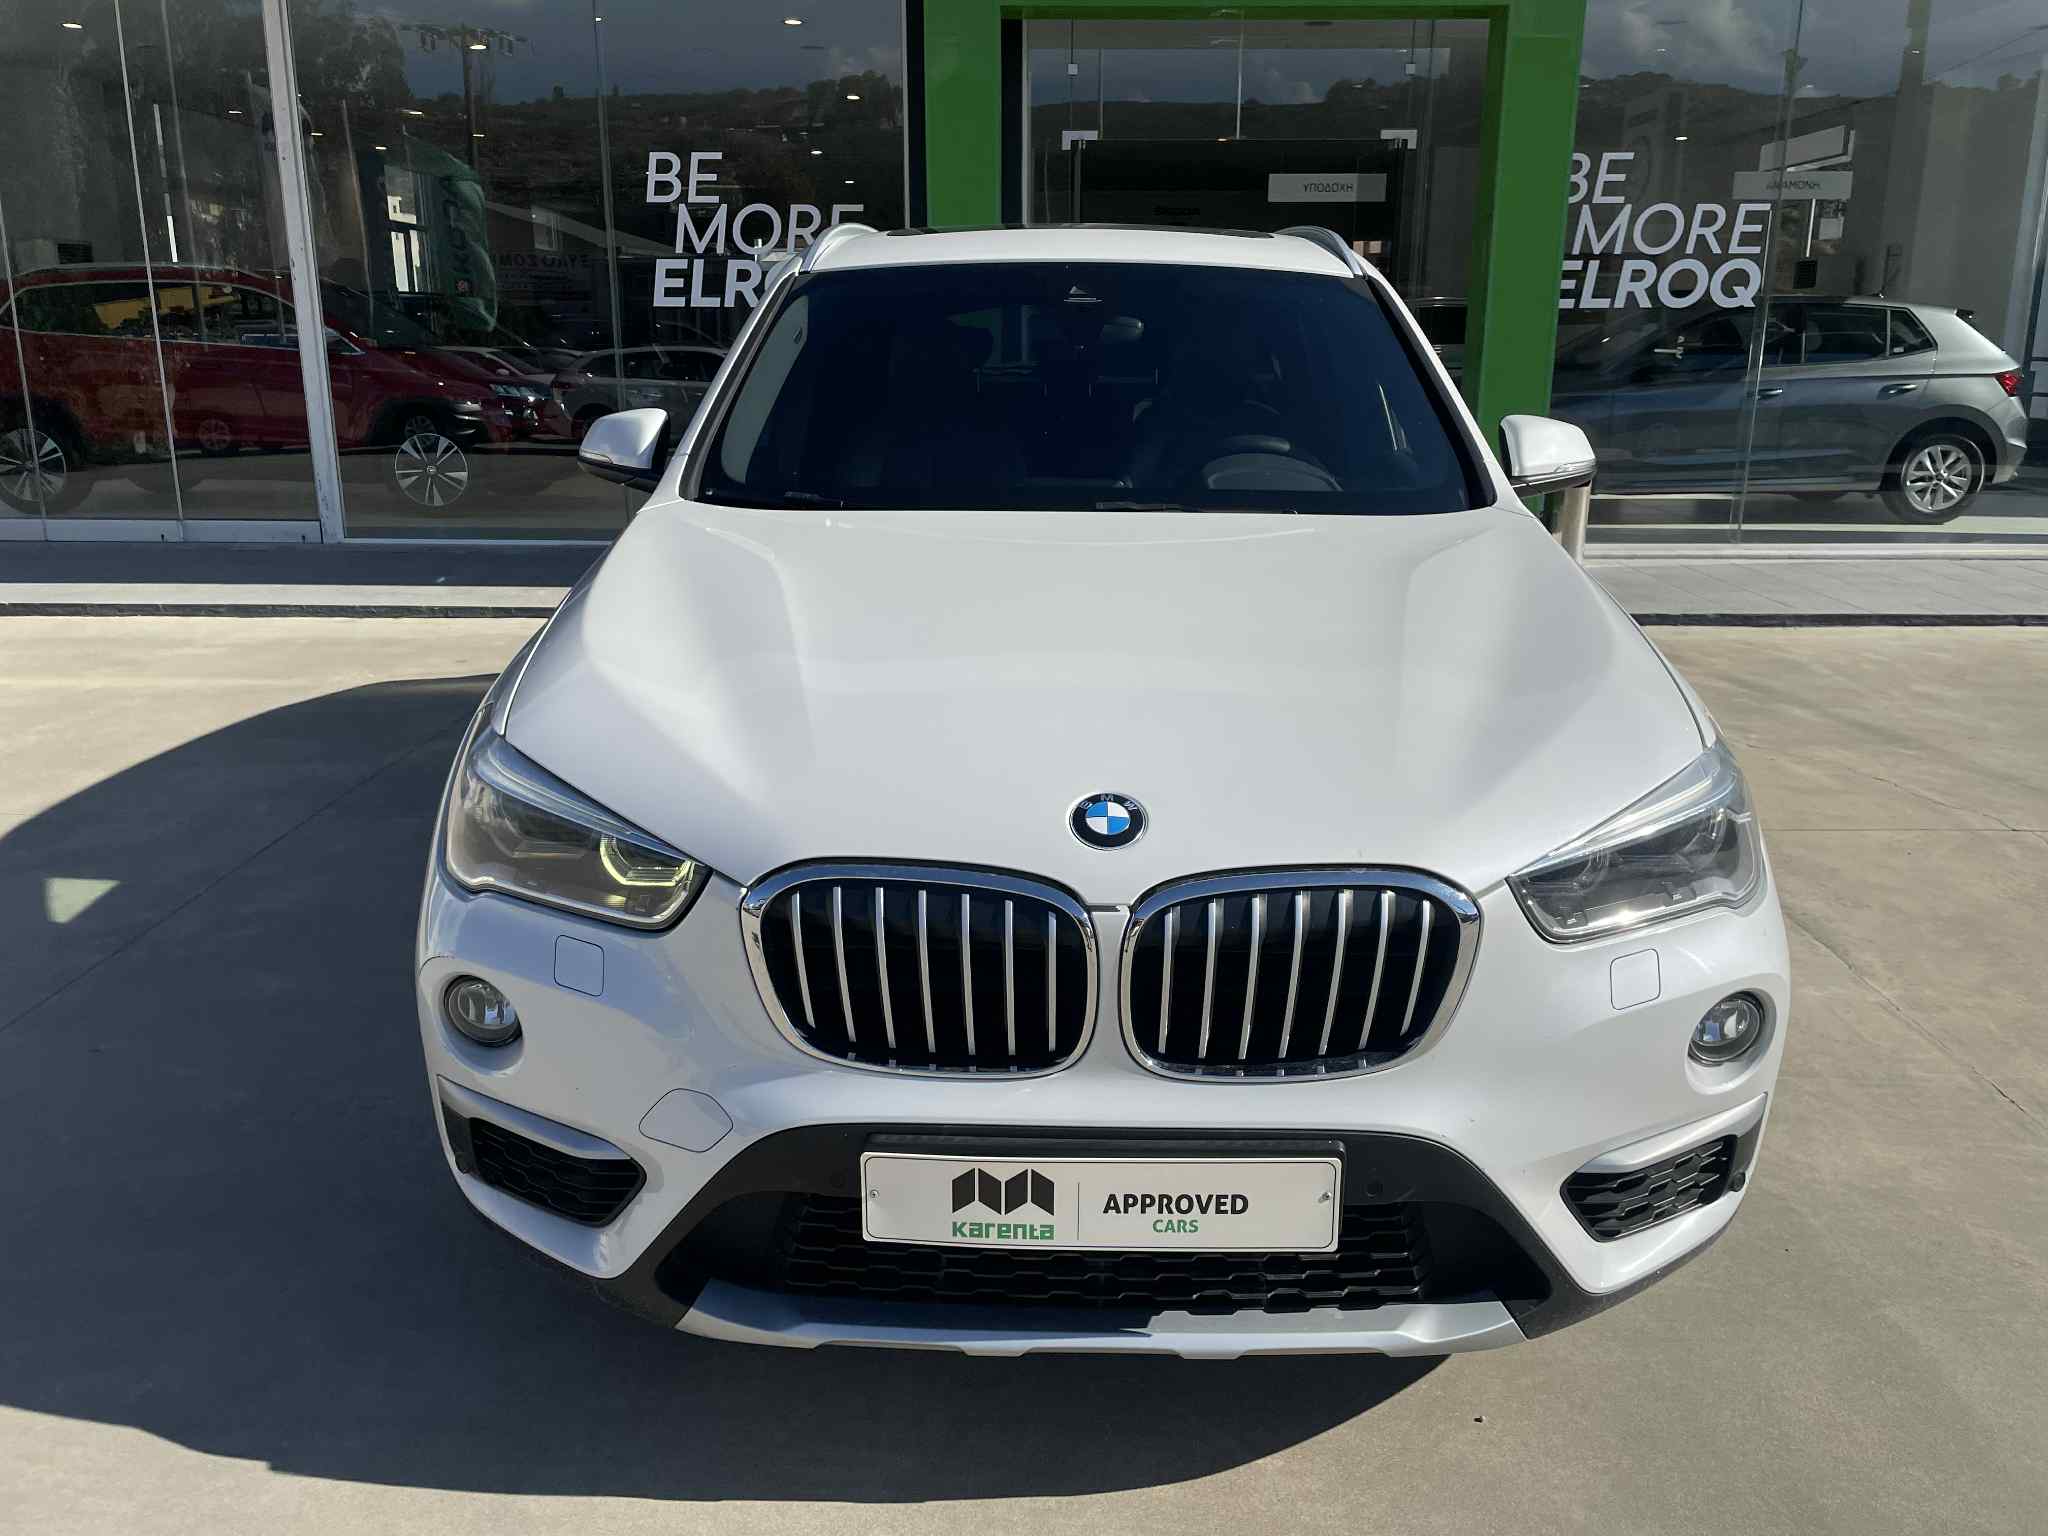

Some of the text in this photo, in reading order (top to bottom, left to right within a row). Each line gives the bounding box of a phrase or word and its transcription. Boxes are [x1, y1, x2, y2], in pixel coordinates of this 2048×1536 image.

[646, 152, 723, 204] BE
[1568, 152, 1635, 204] BE
[1571, 203, 1772, 255] MORE
[653, 258, 786, 307] ELR
[1558, 258, 1762, 309] ELROQ
[1102, 1193, 1250, 1215] APPROVED
[1152, 1218, 1200, 1234] CARS
